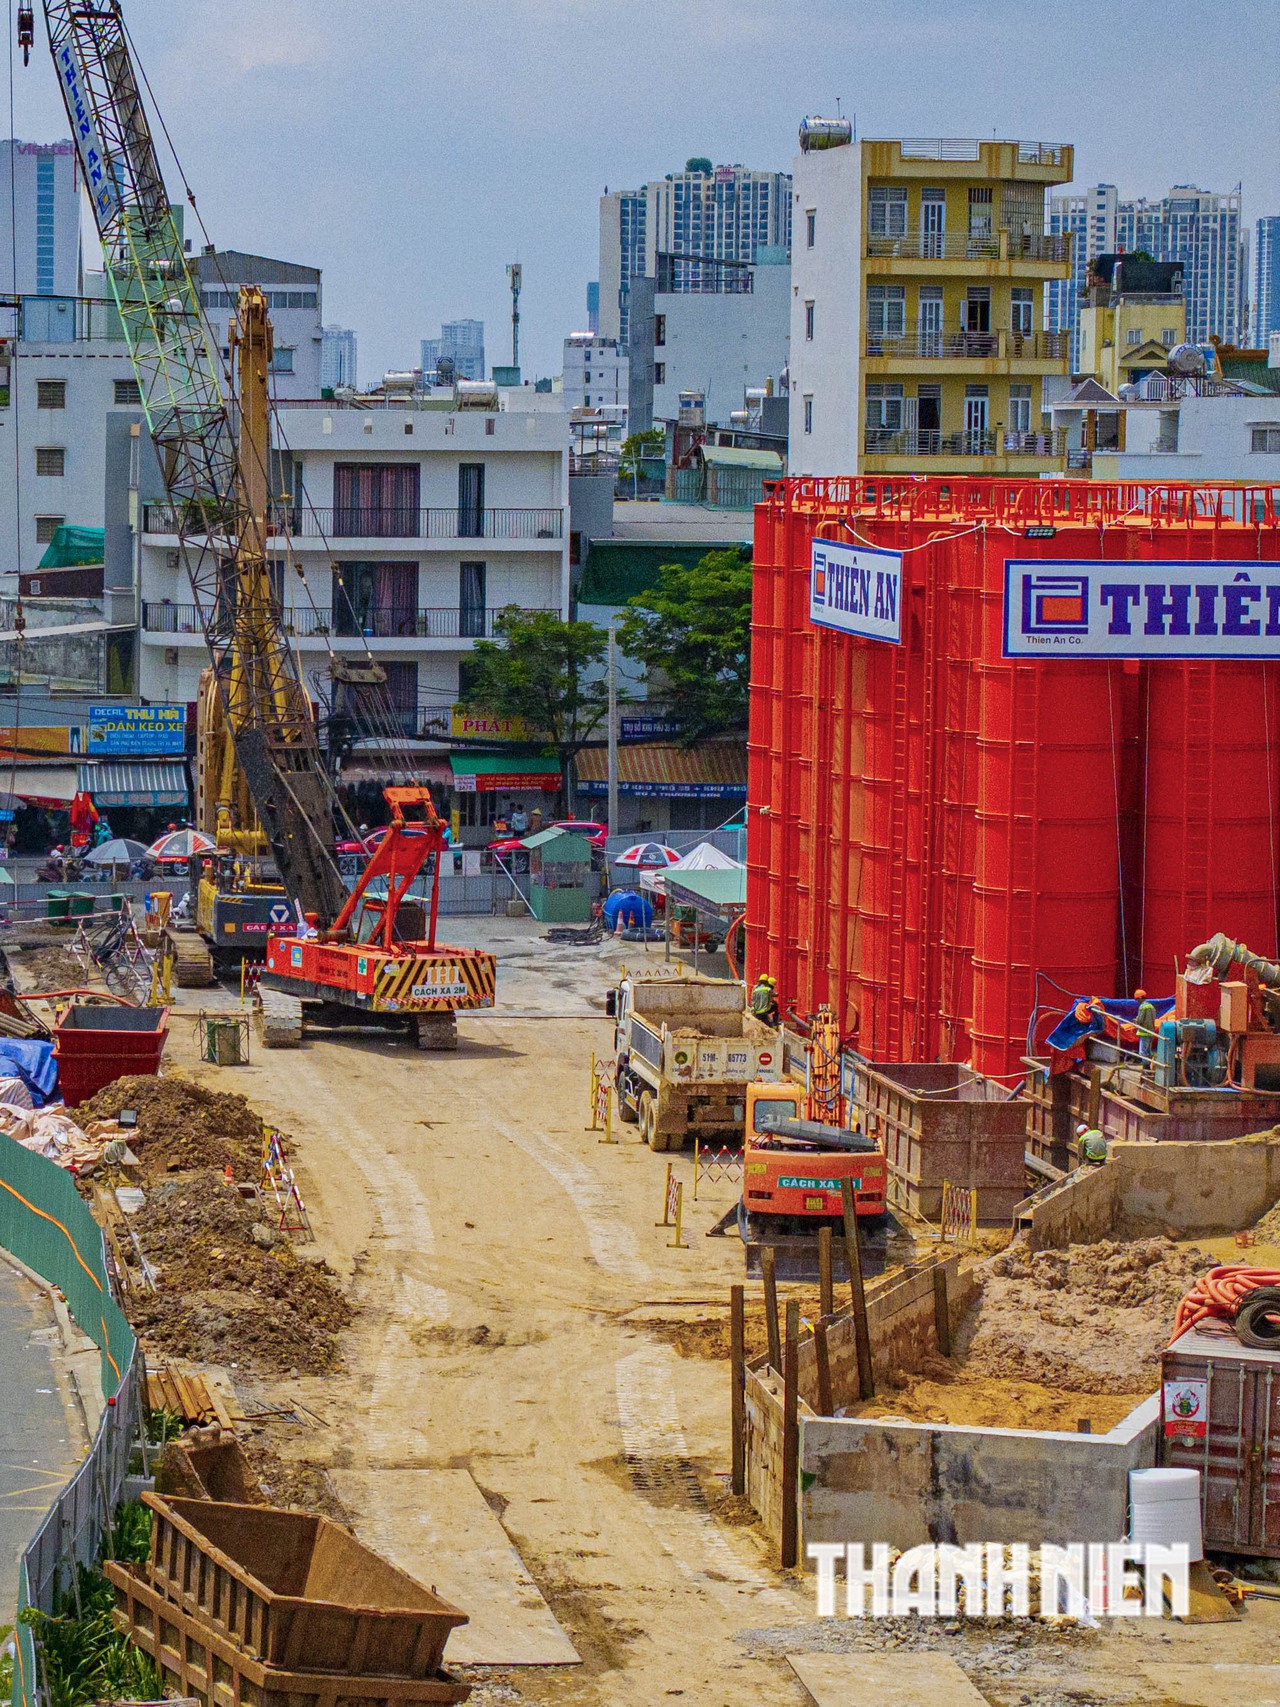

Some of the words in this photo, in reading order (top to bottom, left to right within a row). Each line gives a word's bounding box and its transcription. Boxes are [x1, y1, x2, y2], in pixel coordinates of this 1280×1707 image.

[87, 147, 103, 188] AN
[827, 555, 871, 617] THIÊN
[874, 571, 898, 622] AN
[1026, 635, 1052, 645] Thien
[1053, 635, 1066, 645] An
[1068, 635, 1084, 645] Co.
[94, 708, 124, 716] DECAL
[125, 708, 155, 720] THU
[107, 720, 135, 732] DÁN
[139, 721, 164, 732] KEO
[167, 721, 183, 732] XE
[426, 966, 460, 985] IHI
[413, 984, 439, 997] CÁCH
[439, 986, 453, 996] XA
[453, 985, 467, 996] 2M
[782, 1176, 815, 1188] CÁCH
[818, 1179, 835, 1189] XA
